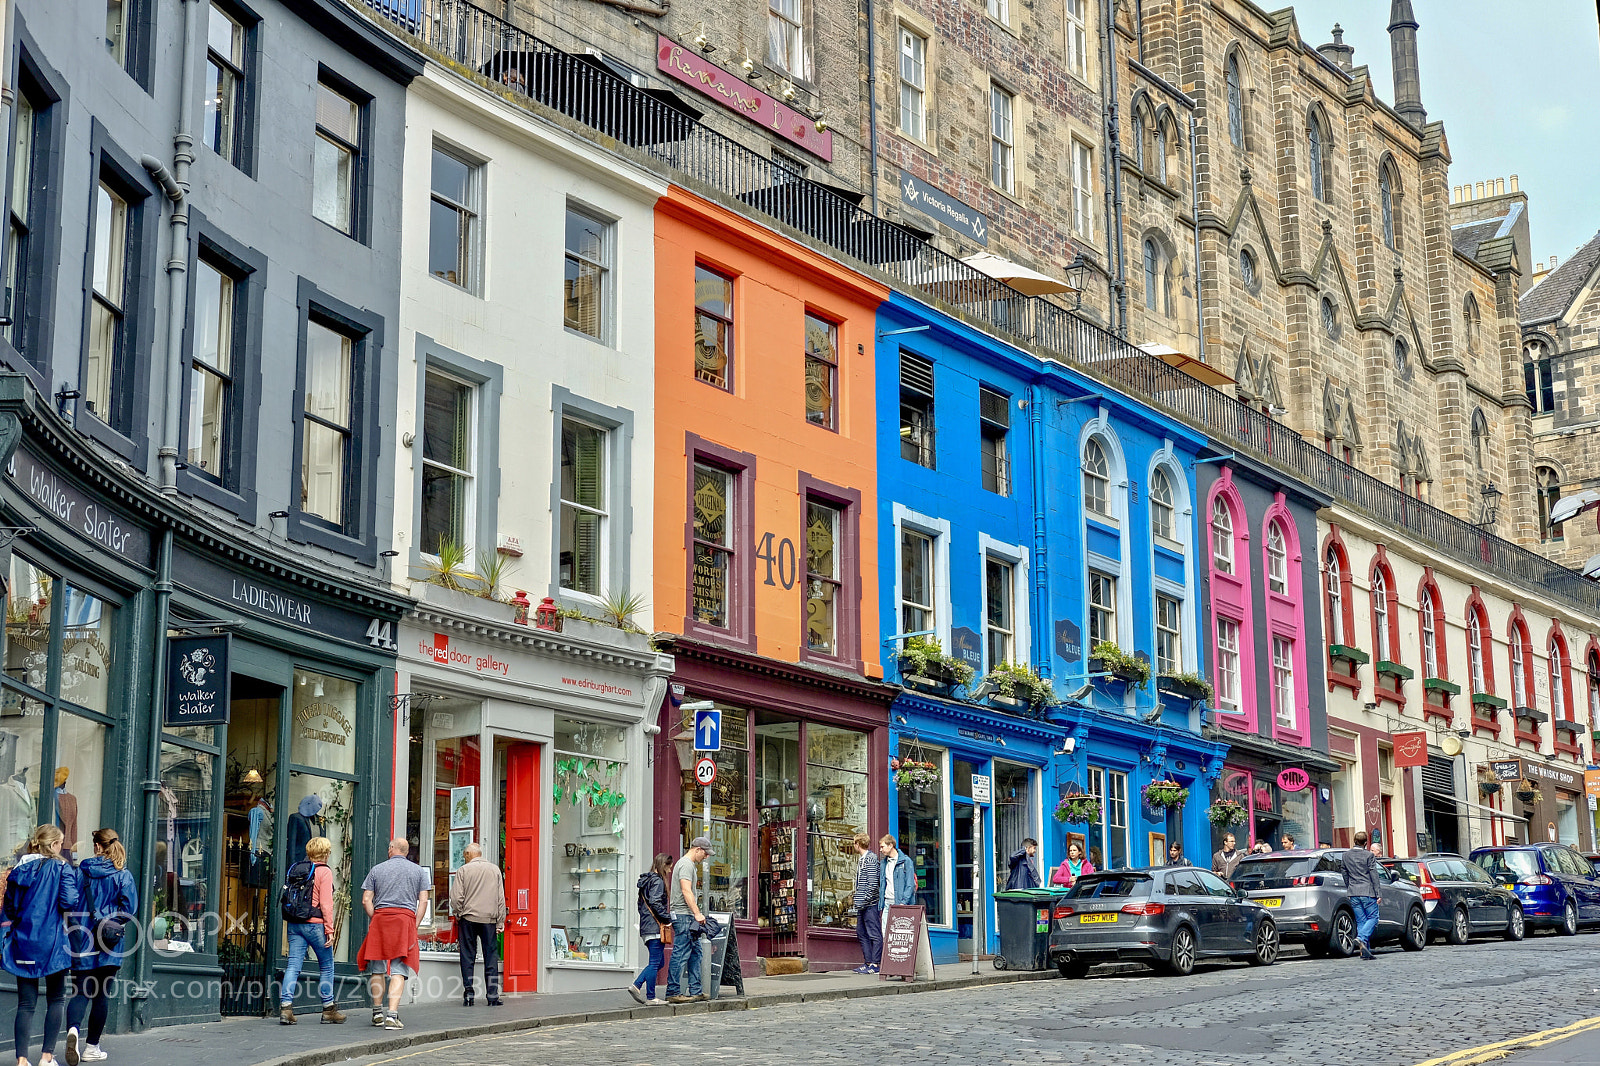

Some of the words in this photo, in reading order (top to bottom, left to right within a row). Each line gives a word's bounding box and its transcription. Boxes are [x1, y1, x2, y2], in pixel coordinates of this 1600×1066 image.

[922, 190, 946, 213] Victoria
[947, 204, 970, 226] Regalia
[30, 464, 76, 522] Walker
[84, 503, 131, 553] Slater
[697, 492, 722, 512] ORIGINAL
[755, 531, 796, 591] 40
[232, 579, 312, 625] LADIESWEAR
[419, 639, 434, 656] the
[434, 645, 448, 660] red
[449, 646, 472, 665] door
[476, 654, 509, 676] gallery
[963, 649, 981, 663] BLEUE
[1065, 643, 1081, 656] BLEUE
[562, 676, 632, 697] www.edinburghart.com
[179, 701, 215, 715] Slater
[322, 702, 353, 738] LUGGAGE
[698, 765, 714, 778] 20
[1527, 764, 1538, 775] THE
[1538, 766, 1559, 781] WHISKY
[1559, 772, 1574, 784] SHOP
[685, 818, 741, 851] MUEUM
[516, 916, 528, 927] 42
[1101, 913, 1115, 922] WUE
[888, 933, 915, 944] MUSEUM
